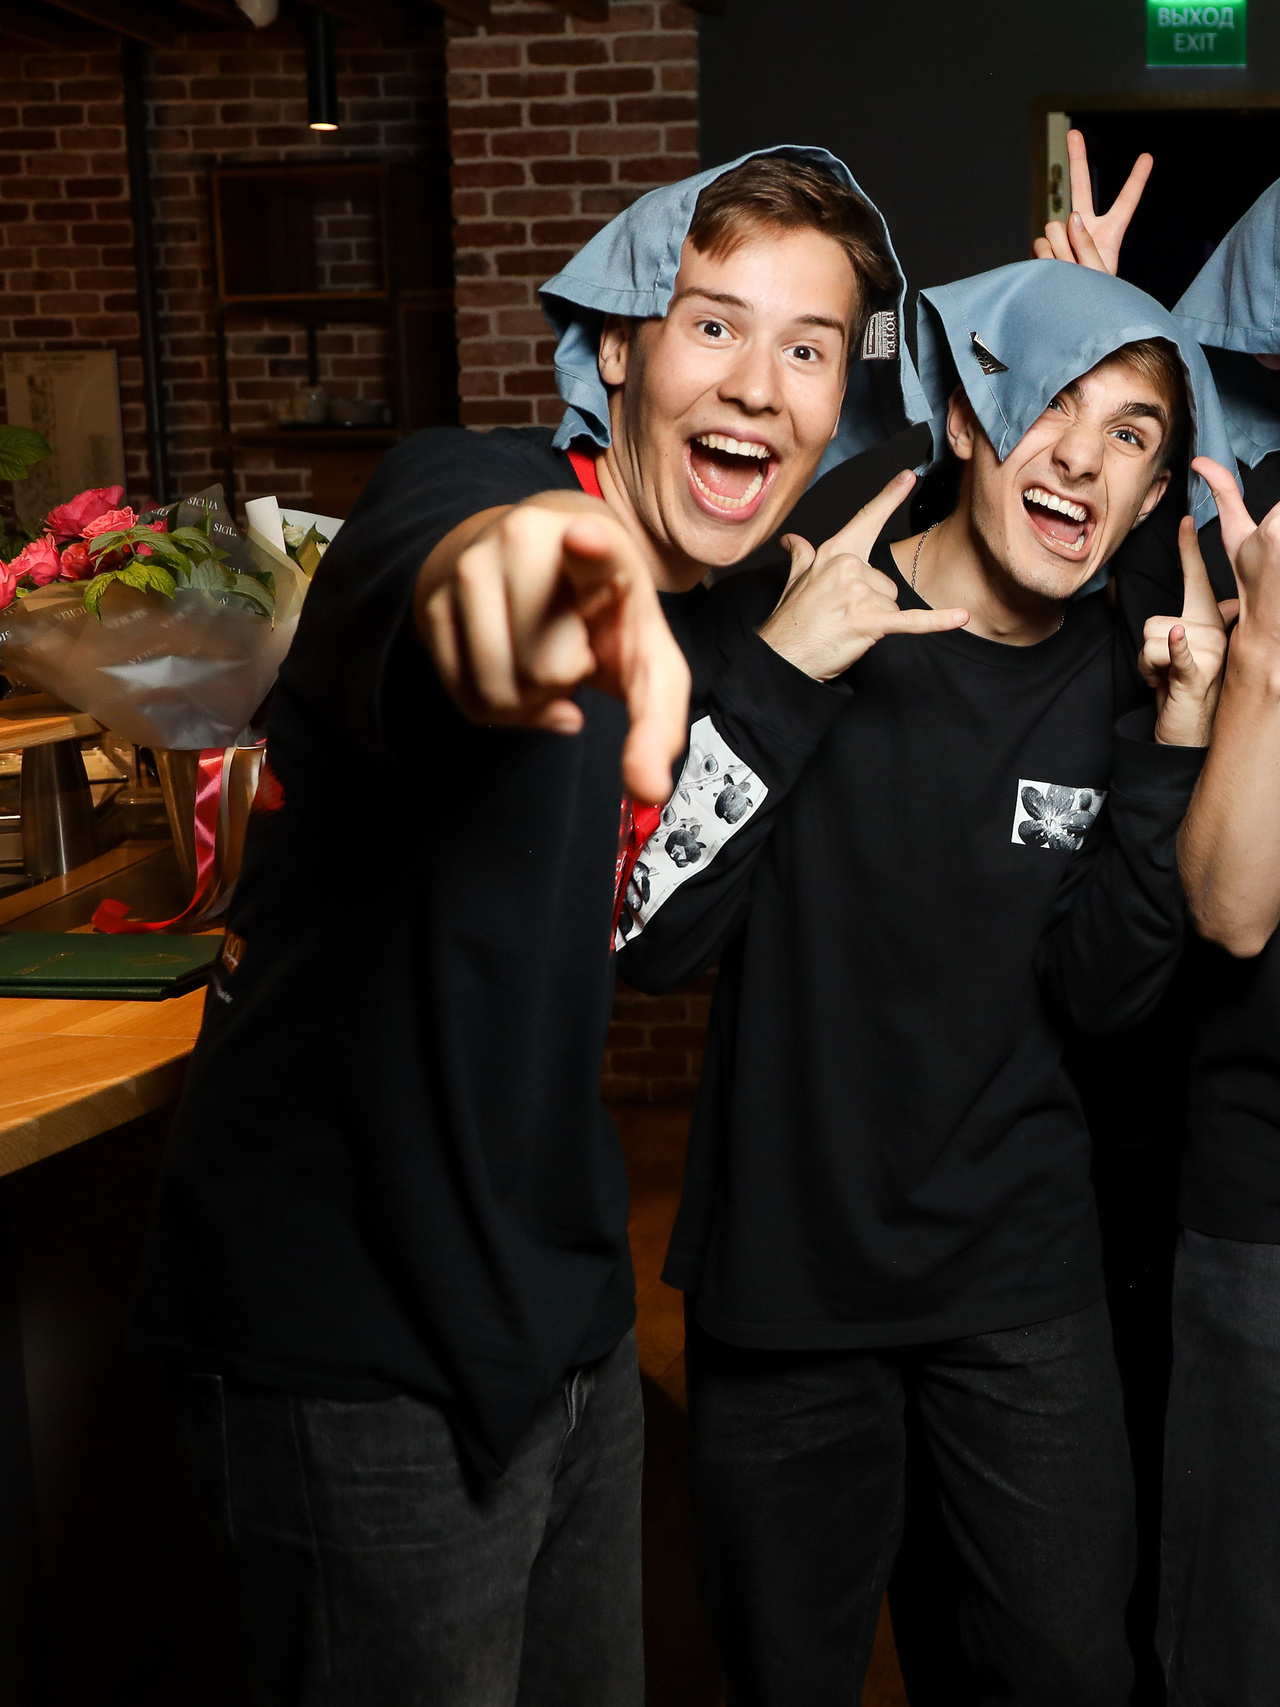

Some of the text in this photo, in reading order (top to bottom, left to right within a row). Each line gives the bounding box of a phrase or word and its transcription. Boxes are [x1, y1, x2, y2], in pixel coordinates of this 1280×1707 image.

[1157, 7, 1235, 29] ВЫХОД
[1174, 32, 1217, 52] EXIT
[886, 311, 897, 359] HOTEL
[187, 497, 218, 510] SICIIA
[213, 522, 237, 537] SICIL
